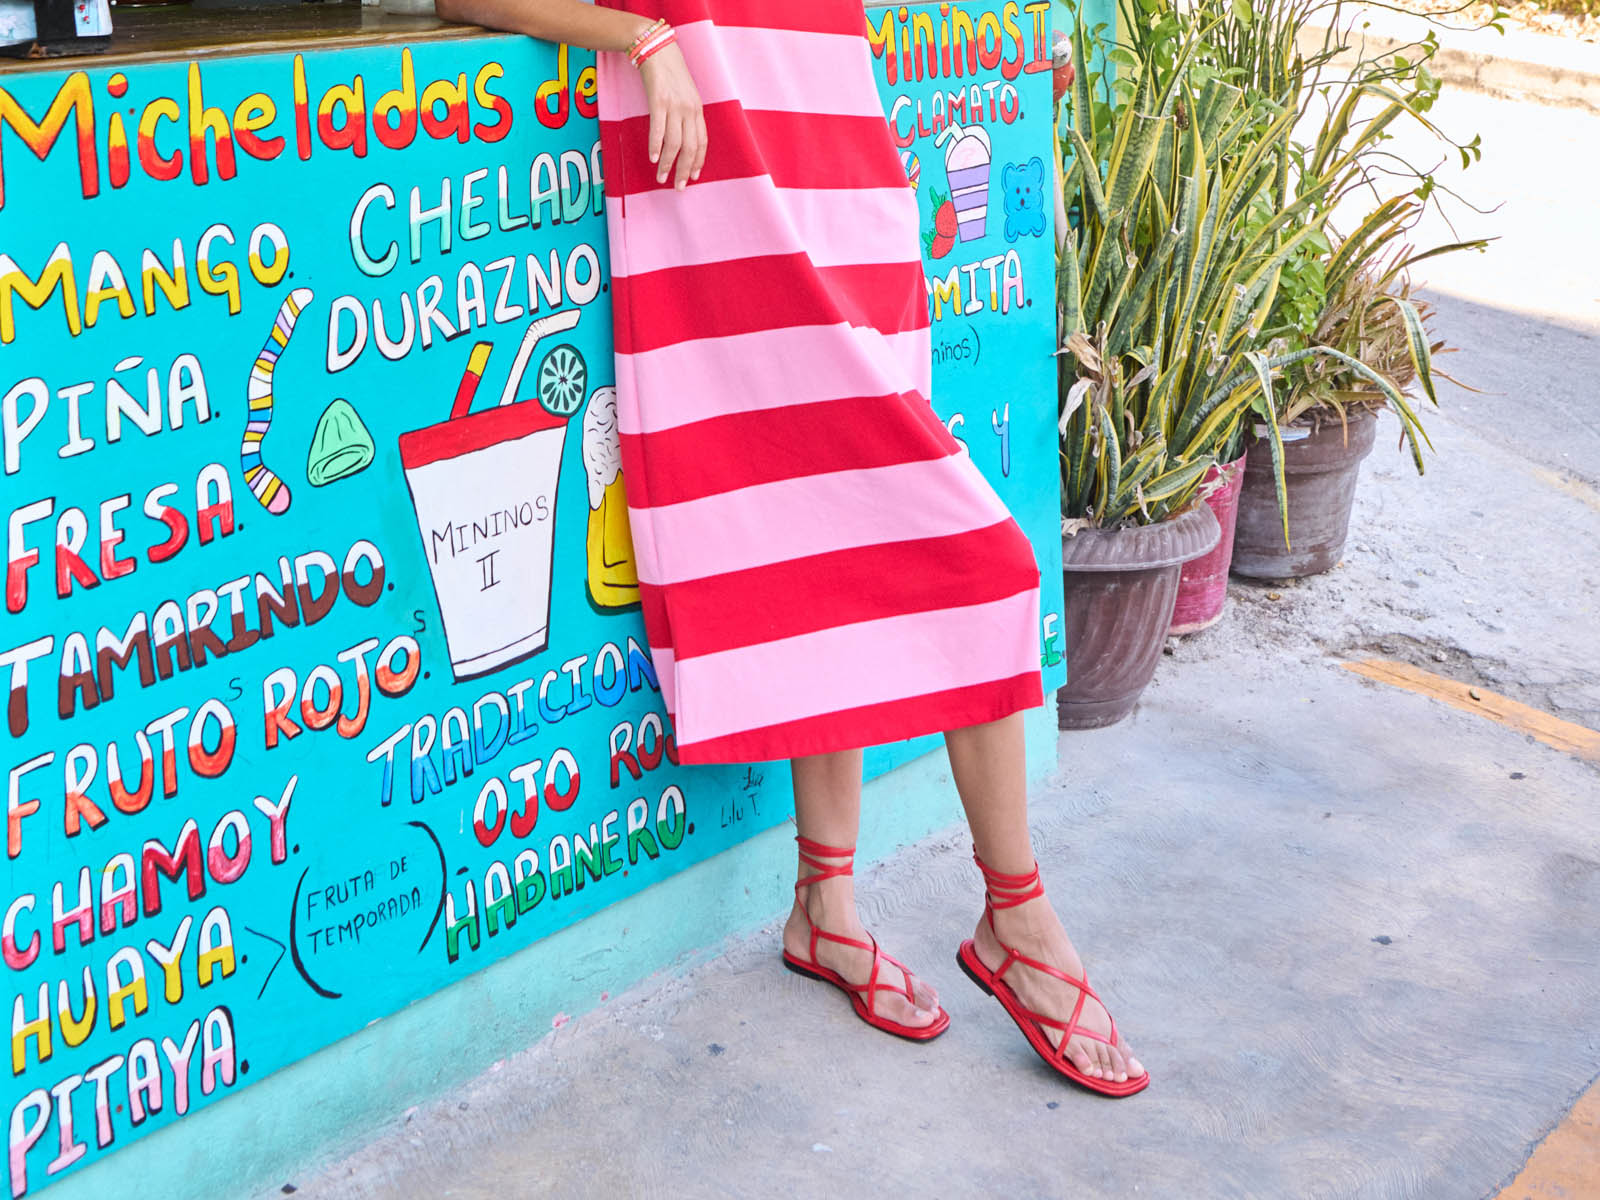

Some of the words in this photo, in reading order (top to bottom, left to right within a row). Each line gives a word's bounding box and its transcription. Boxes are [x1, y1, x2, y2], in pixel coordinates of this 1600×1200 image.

[0, 46, 514, 209] Micheladas
[533, 41, 599, 130] de
[889, 80, 1025, 149] CLAMATO.
[0, 221, 296, 347] MANGO.
[325, 242, 610, 375] DURAZNO.
[926, 247, 1034, 326] MITA.
[1, 352, 221, 476] PIÑA.
[6, 461, 246, 615] FRESA.
[431, 495, 550, 566] MININOS
[476, 549, 500, 592] II
[0, 538, 396, 739] TAMARINDO.
[472, 747, 581, 848] OJO
[1, 773, 301, 971] CHAMOY.
[390, 855, 409, 881] DE
[444, 784, 695, 965] HABANERO.
[10, 905, 250, 1078] HUAYA.
[7, 1005, 250, 1200] PITAYA.
